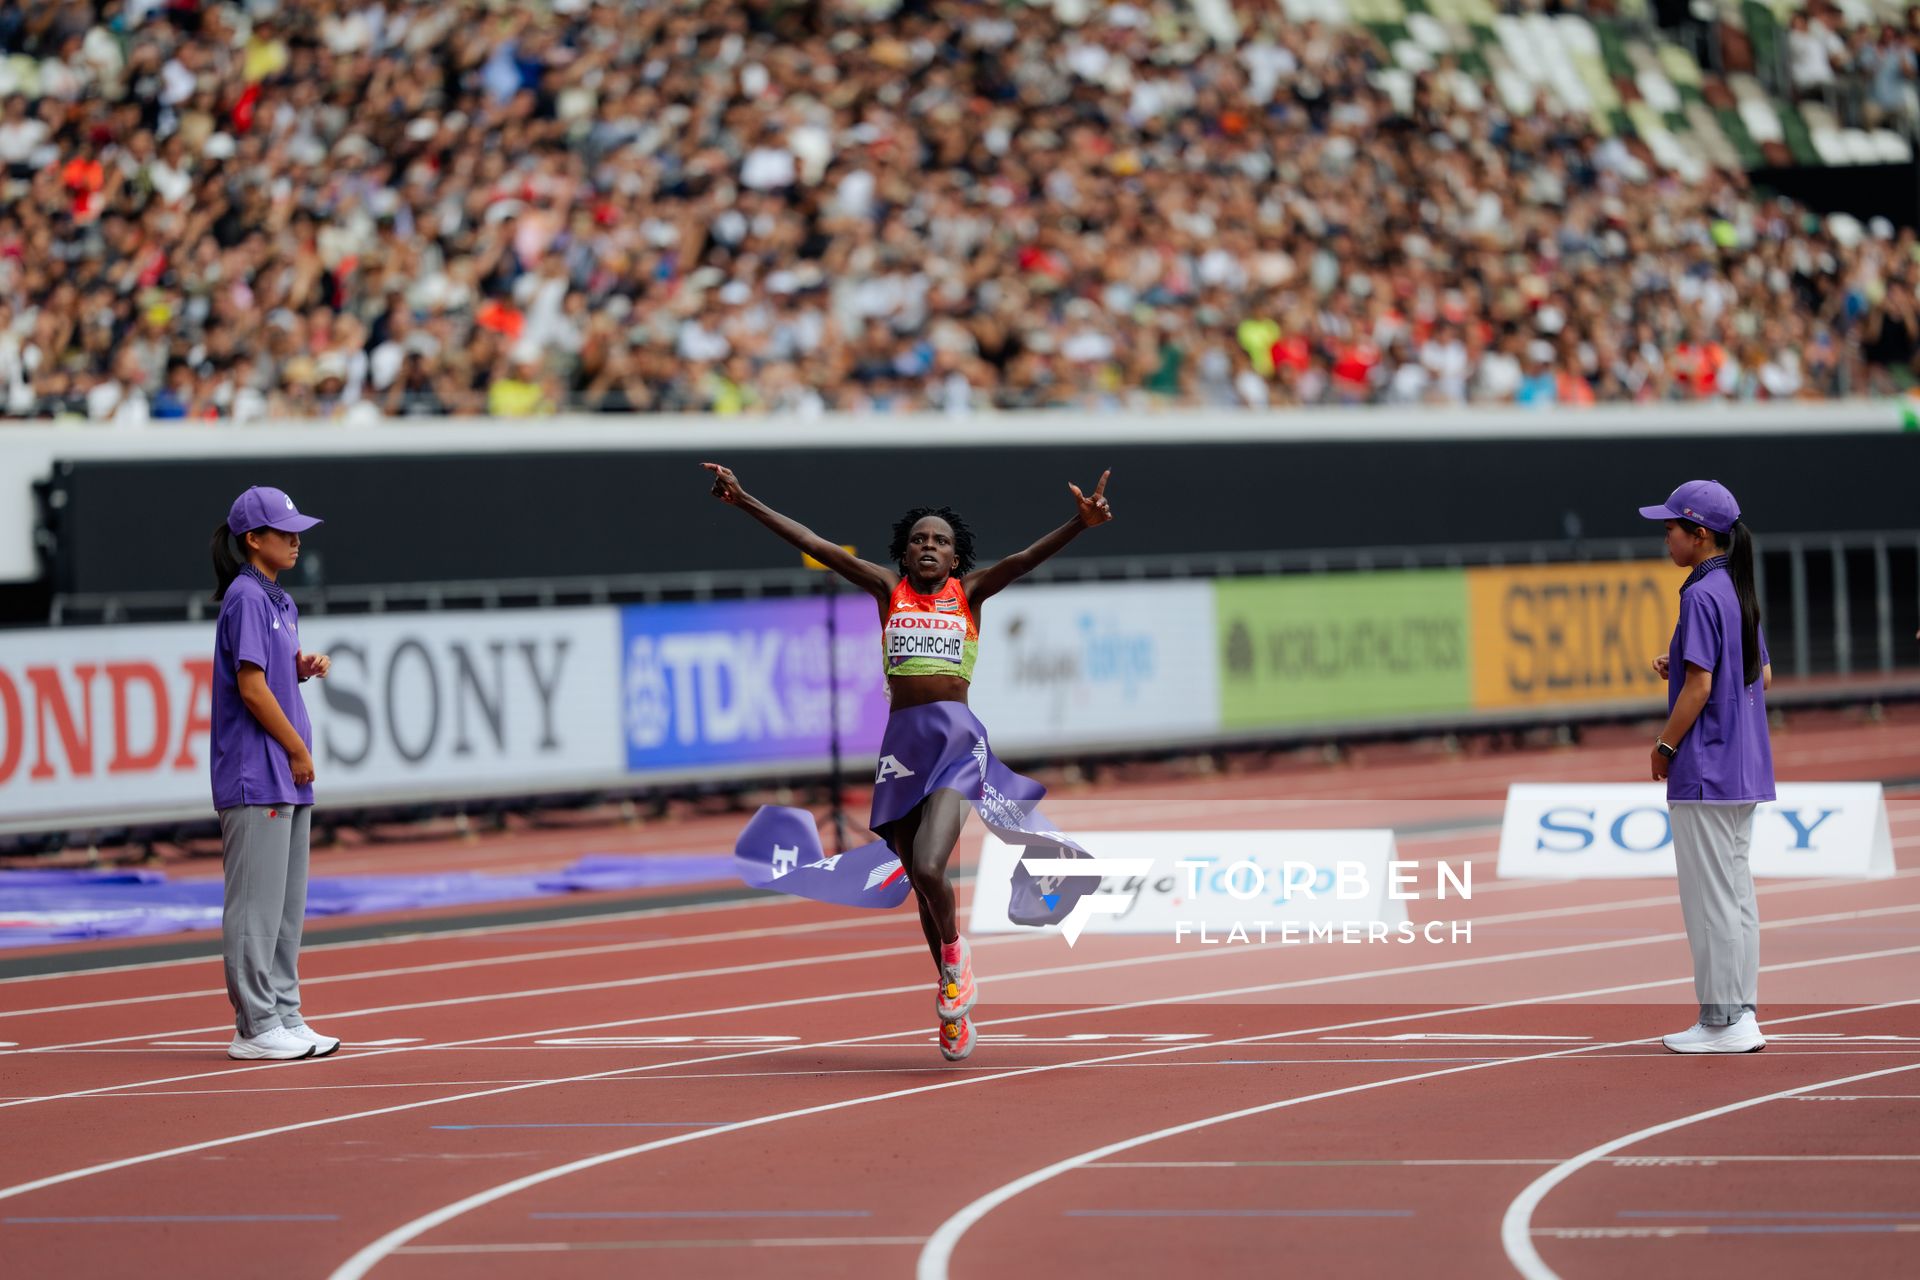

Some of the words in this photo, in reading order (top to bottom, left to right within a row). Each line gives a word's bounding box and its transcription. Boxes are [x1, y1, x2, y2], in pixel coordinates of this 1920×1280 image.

[889, 617, 964, 632] HONDA
[889, 635, 961, 656] JEPCHIRCHIR
[1502, 573, 1671, 693] SEIKO
[321, 637, 573, 769] SONY
[660, 629, 791, 746] TDK
[1537, 807, 1845, 854] SOY
